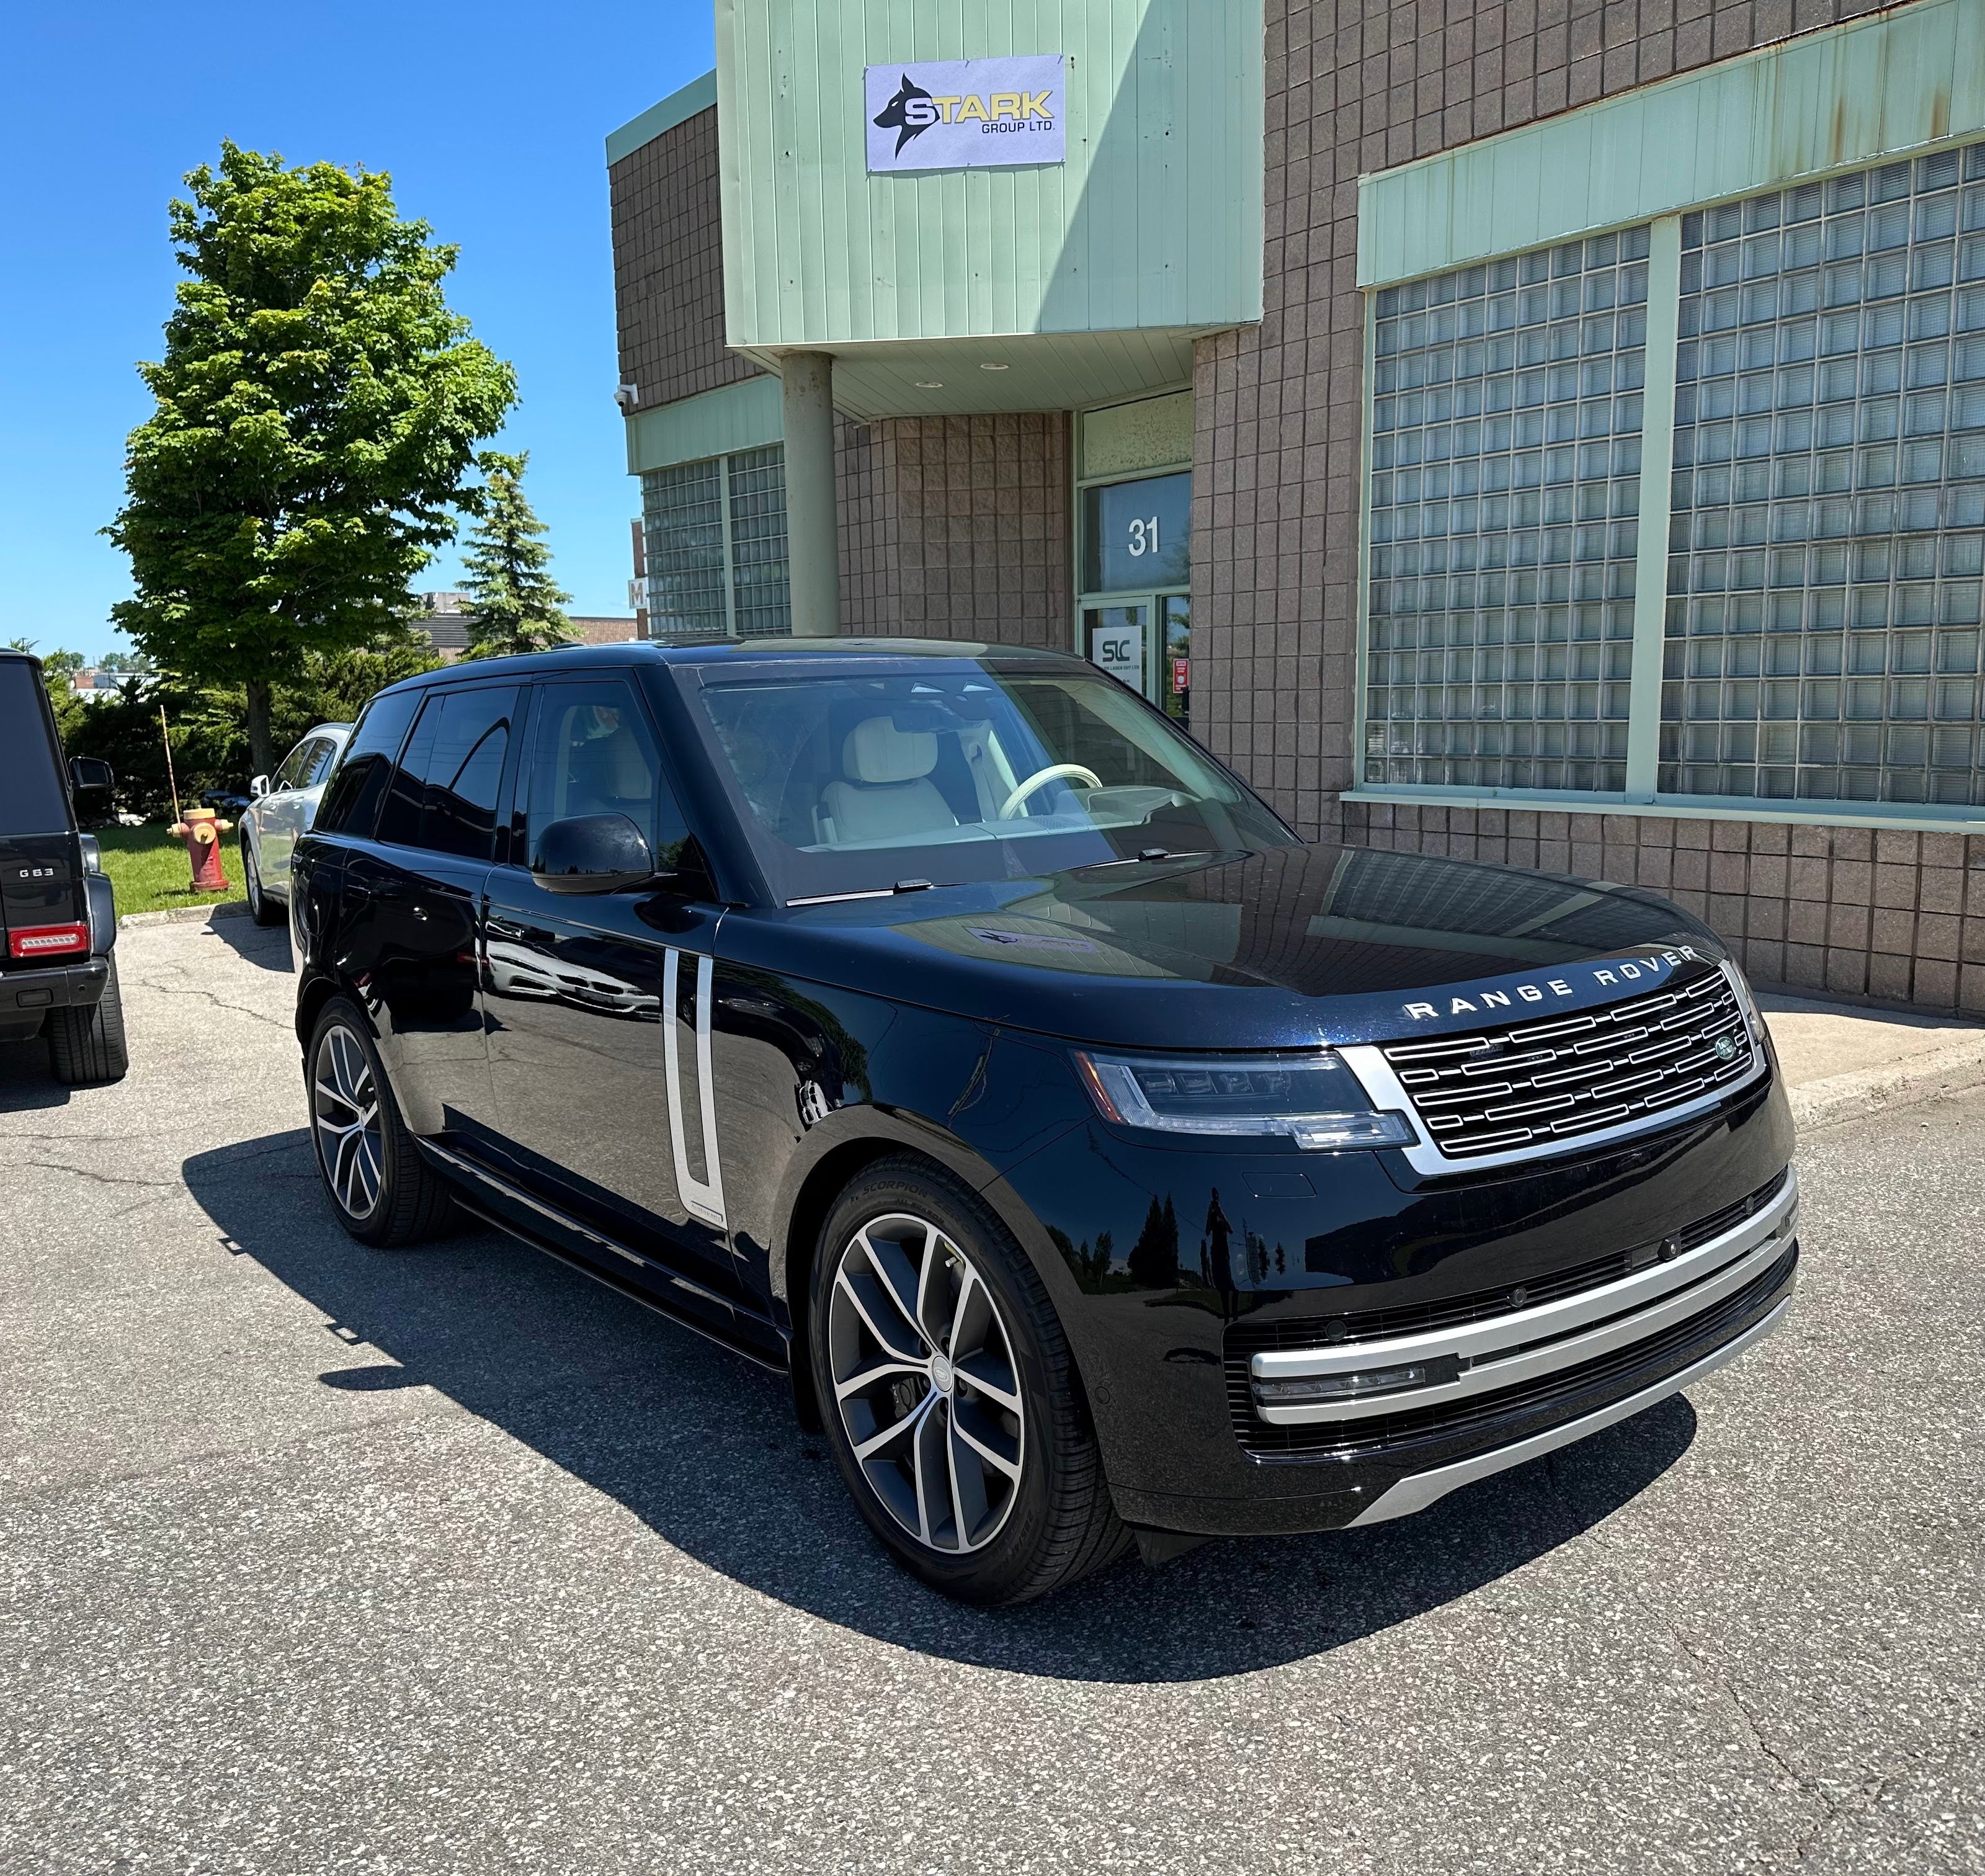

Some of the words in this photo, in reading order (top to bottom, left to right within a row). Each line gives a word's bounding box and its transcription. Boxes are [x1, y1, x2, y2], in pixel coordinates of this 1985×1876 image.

[905, 90, 1055, 126] STARK
[982, 122, 1025, 134] GROUP
[1128, 516, 1159, 557] 31
[1102, 640, 1130, 663] SLC
[1404, 978, 1573, 1020] RANGE
[1593, 945, 1698, 987] ROVER
[863, 1181, 929, 1199] SCORPION
[932, 1197, 972, 1235] ZERO
